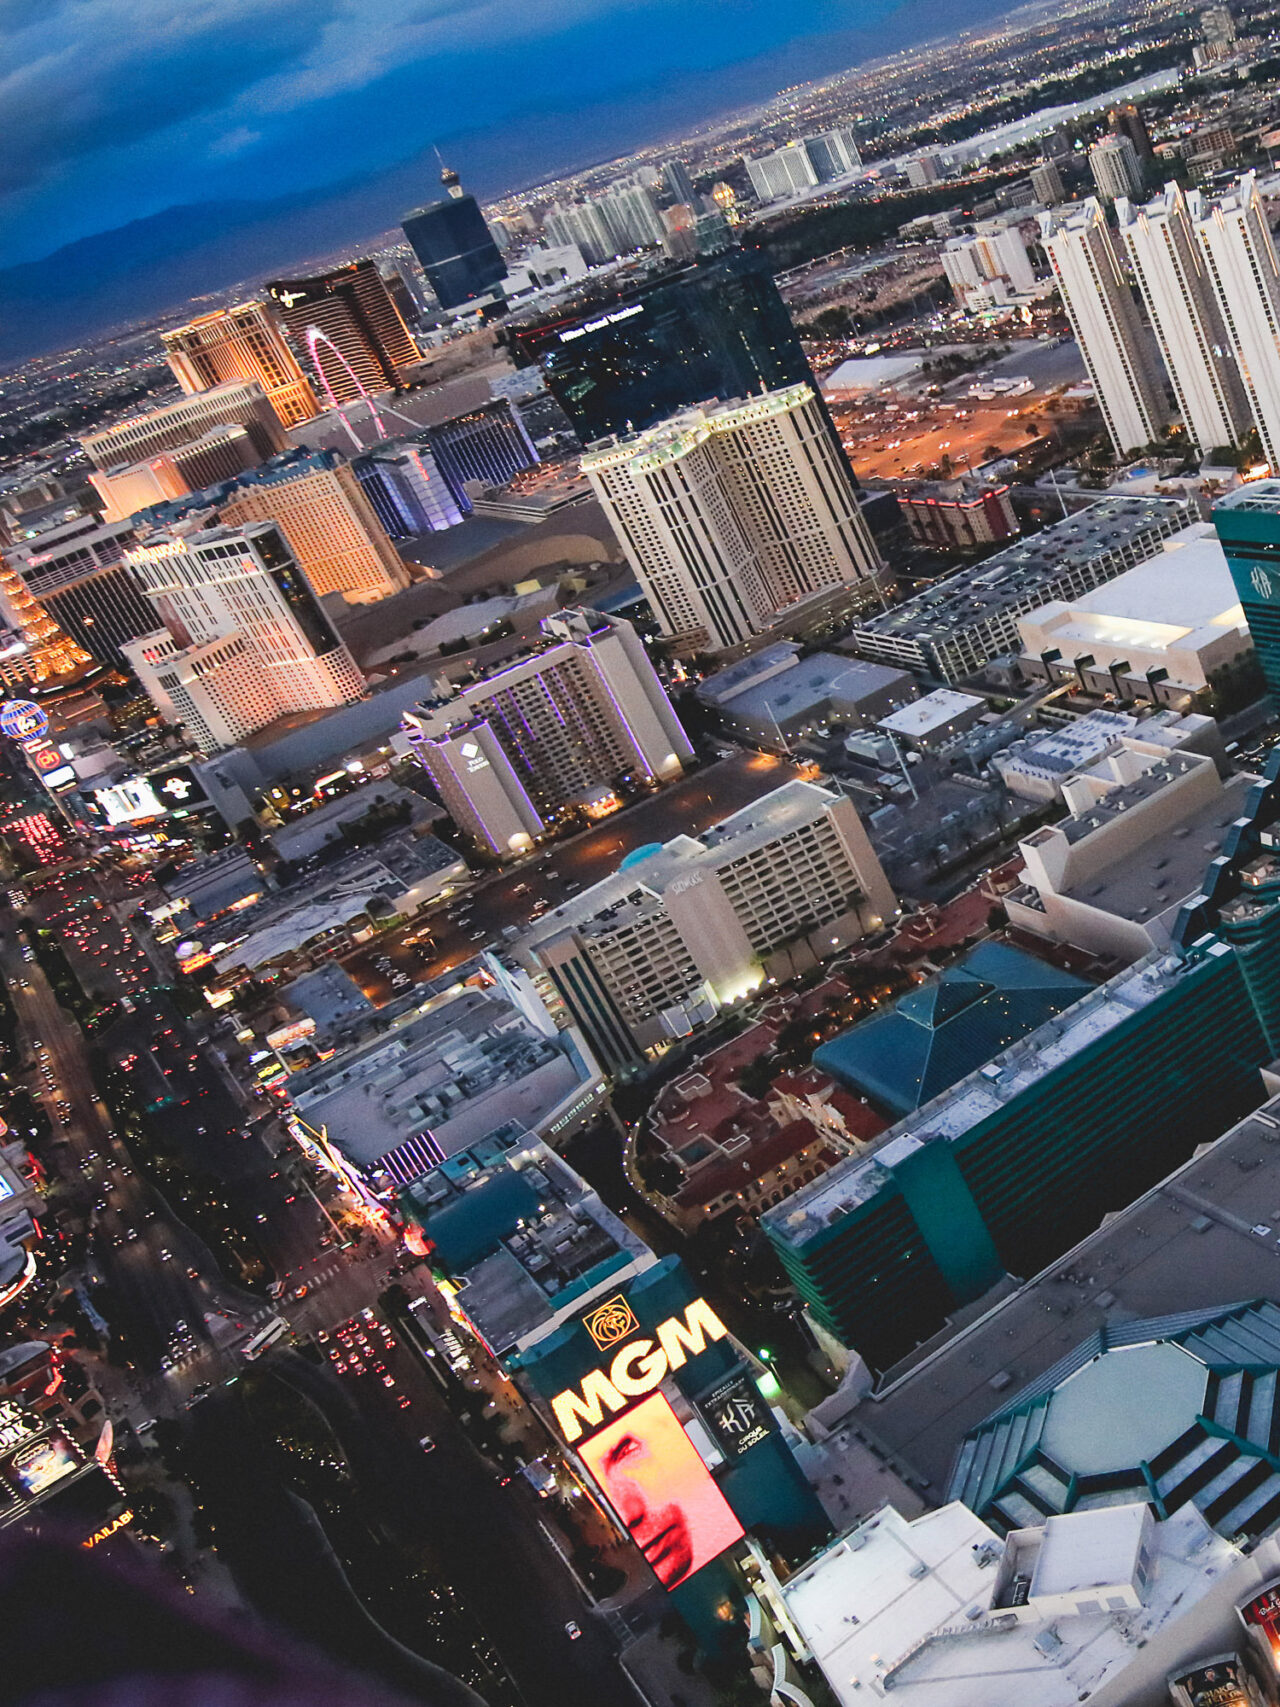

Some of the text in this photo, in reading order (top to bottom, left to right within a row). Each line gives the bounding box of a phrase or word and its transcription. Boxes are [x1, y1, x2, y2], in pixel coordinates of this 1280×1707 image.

[122, 536, 188, 565] hollywood
[551, 1297, 728, 1443] MGM
[737, 1429, 770, 1454] DU SOLEIL
[739, 1425, 763, 1445] CIRQUE
